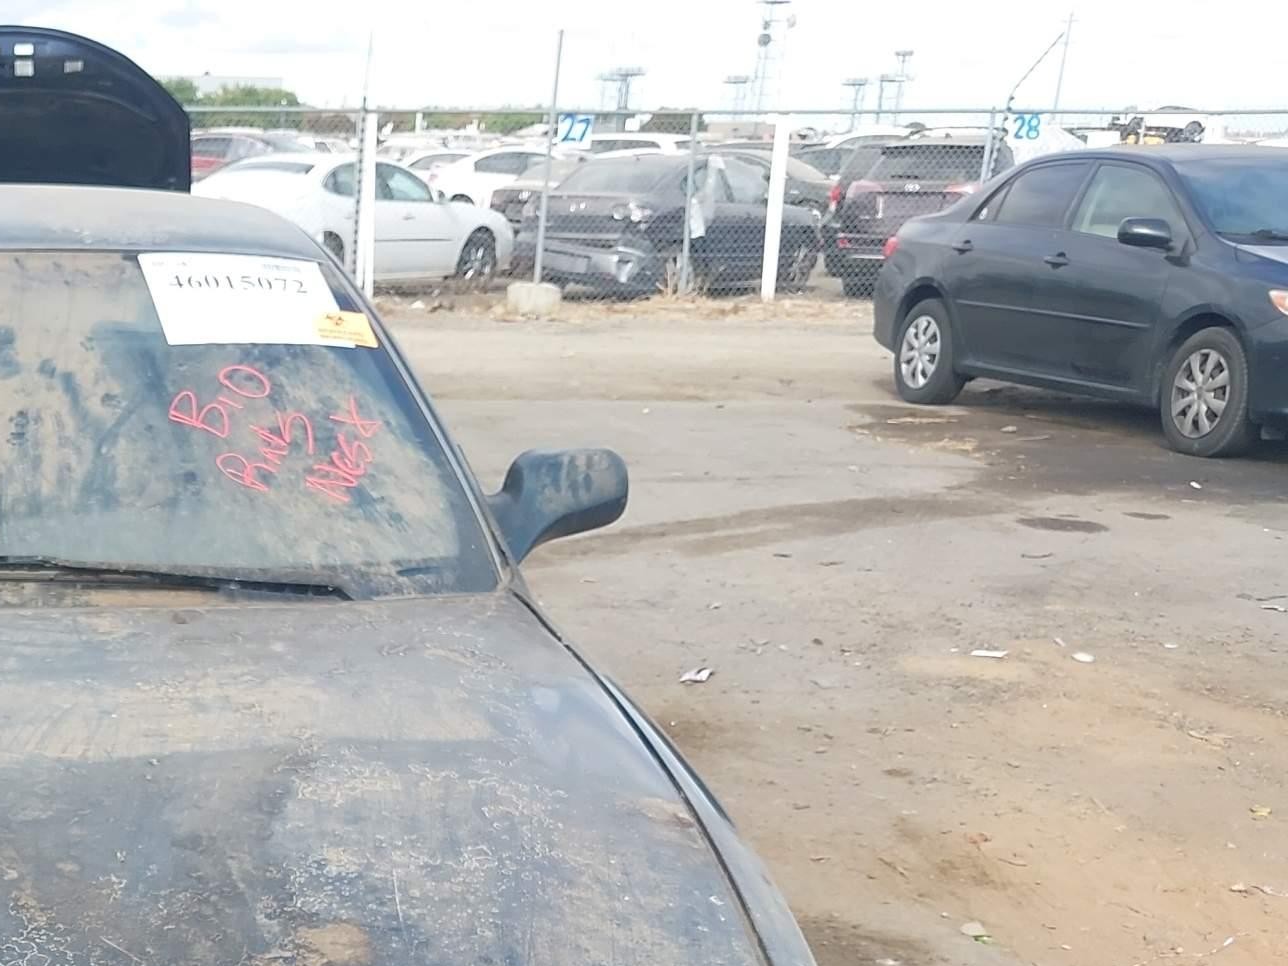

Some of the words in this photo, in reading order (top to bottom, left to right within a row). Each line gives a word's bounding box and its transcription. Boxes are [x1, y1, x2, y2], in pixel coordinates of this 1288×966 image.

[560, 112, 591, 142] 27
[1013, 112, 1041, 140] 28
[169, 274, 308, 294] 46015072
